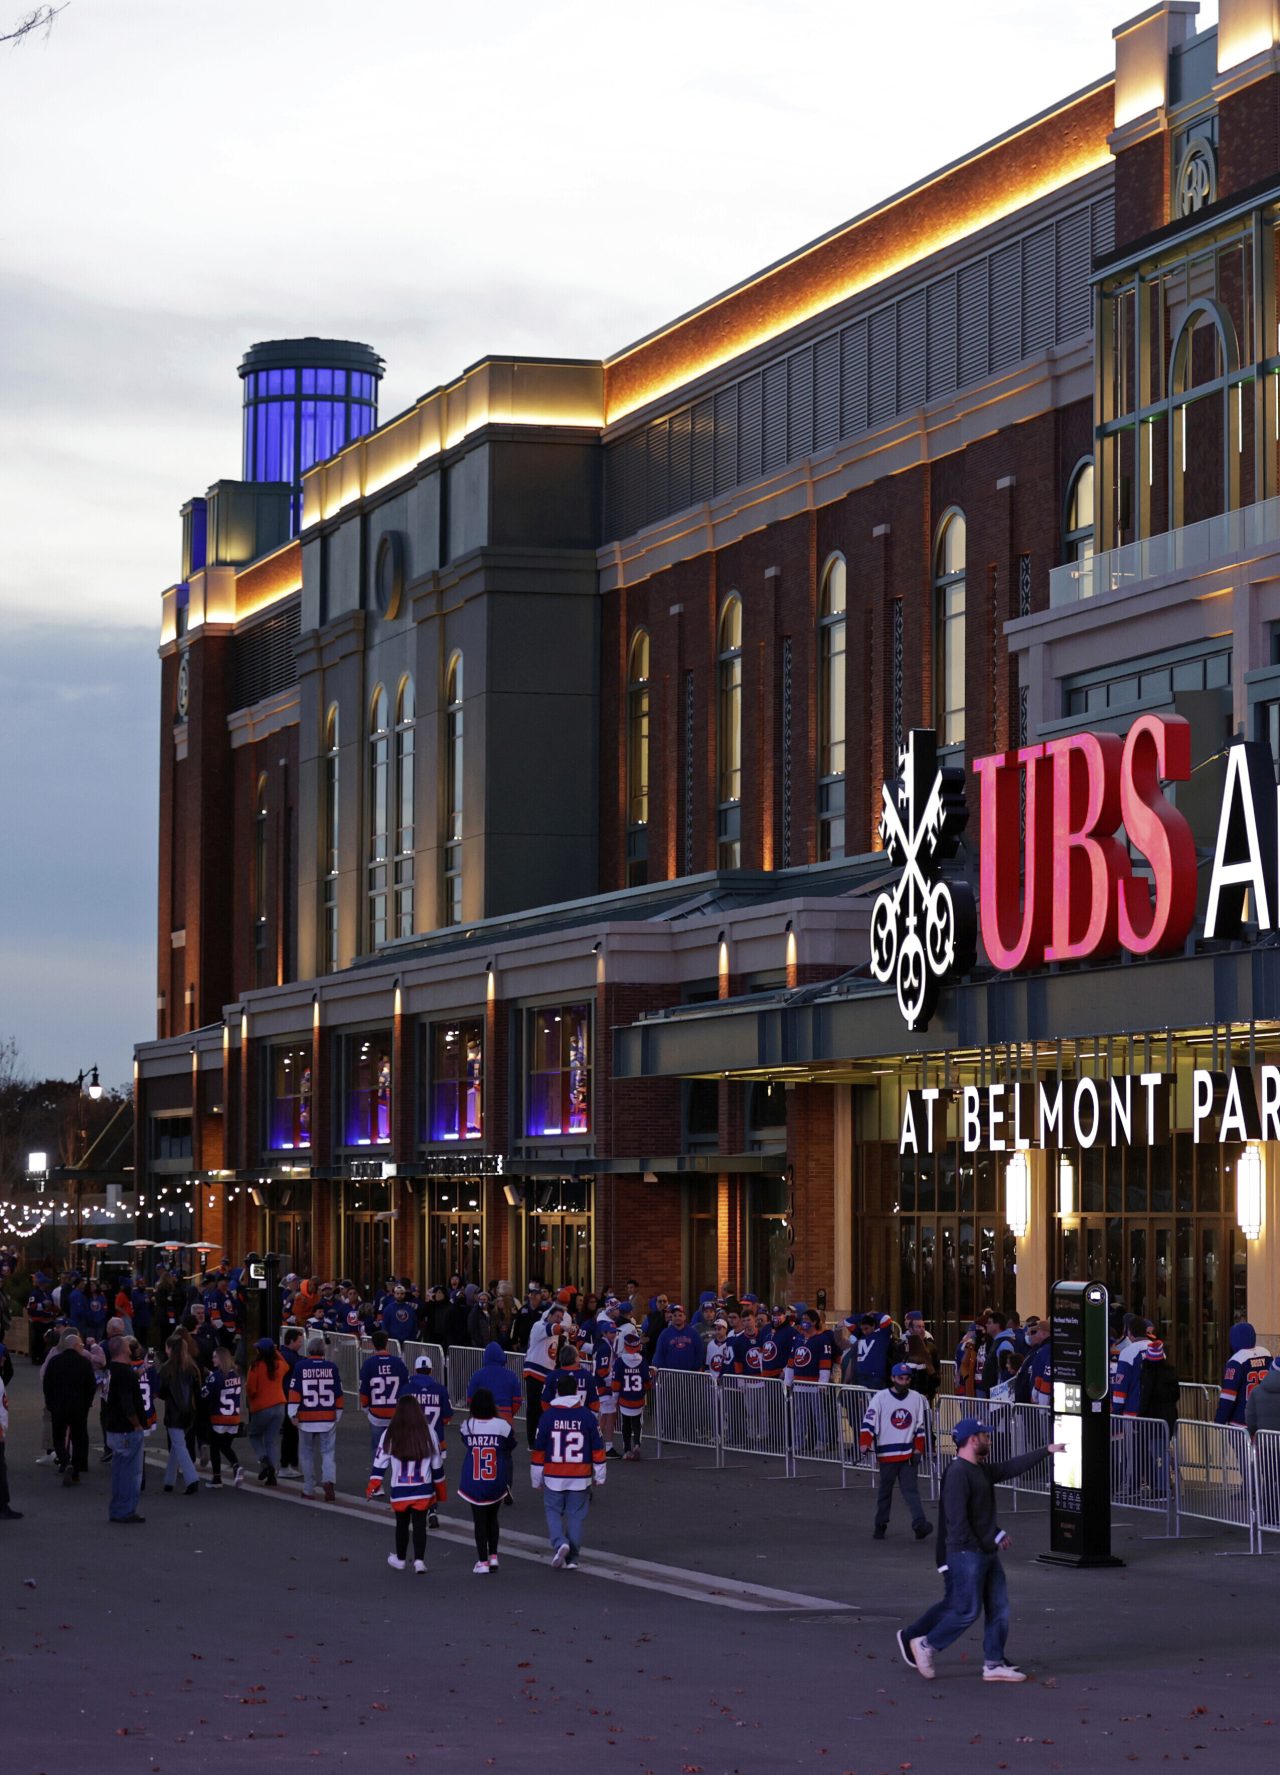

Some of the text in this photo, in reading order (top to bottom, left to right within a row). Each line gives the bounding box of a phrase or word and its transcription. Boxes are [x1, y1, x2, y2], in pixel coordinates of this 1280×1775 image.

[972, 713, 1195, 971] UBS
[899, 1088, 940, 1154] AT
[963, 1072, 1165, 1152] BELMONT
[302, 1368, 334, 1379] BOYCHUK
[378, 1365, 392, 1375] LEE
[623, 1375, 643, 1392] 13
[139, 1382, 151, 1412] 3
[302, 1379, 335, 1408] 55
[369, 1376, 400, 1406] 27
[423, 1406, 441, 1430] 7
[554, 1419, 582, 1431] BAILEY
[467, 1435, 500, 1447] BARZAL
[551, 1430, 585, 1463] 12
[472, 1446, 498, 1481] 13
